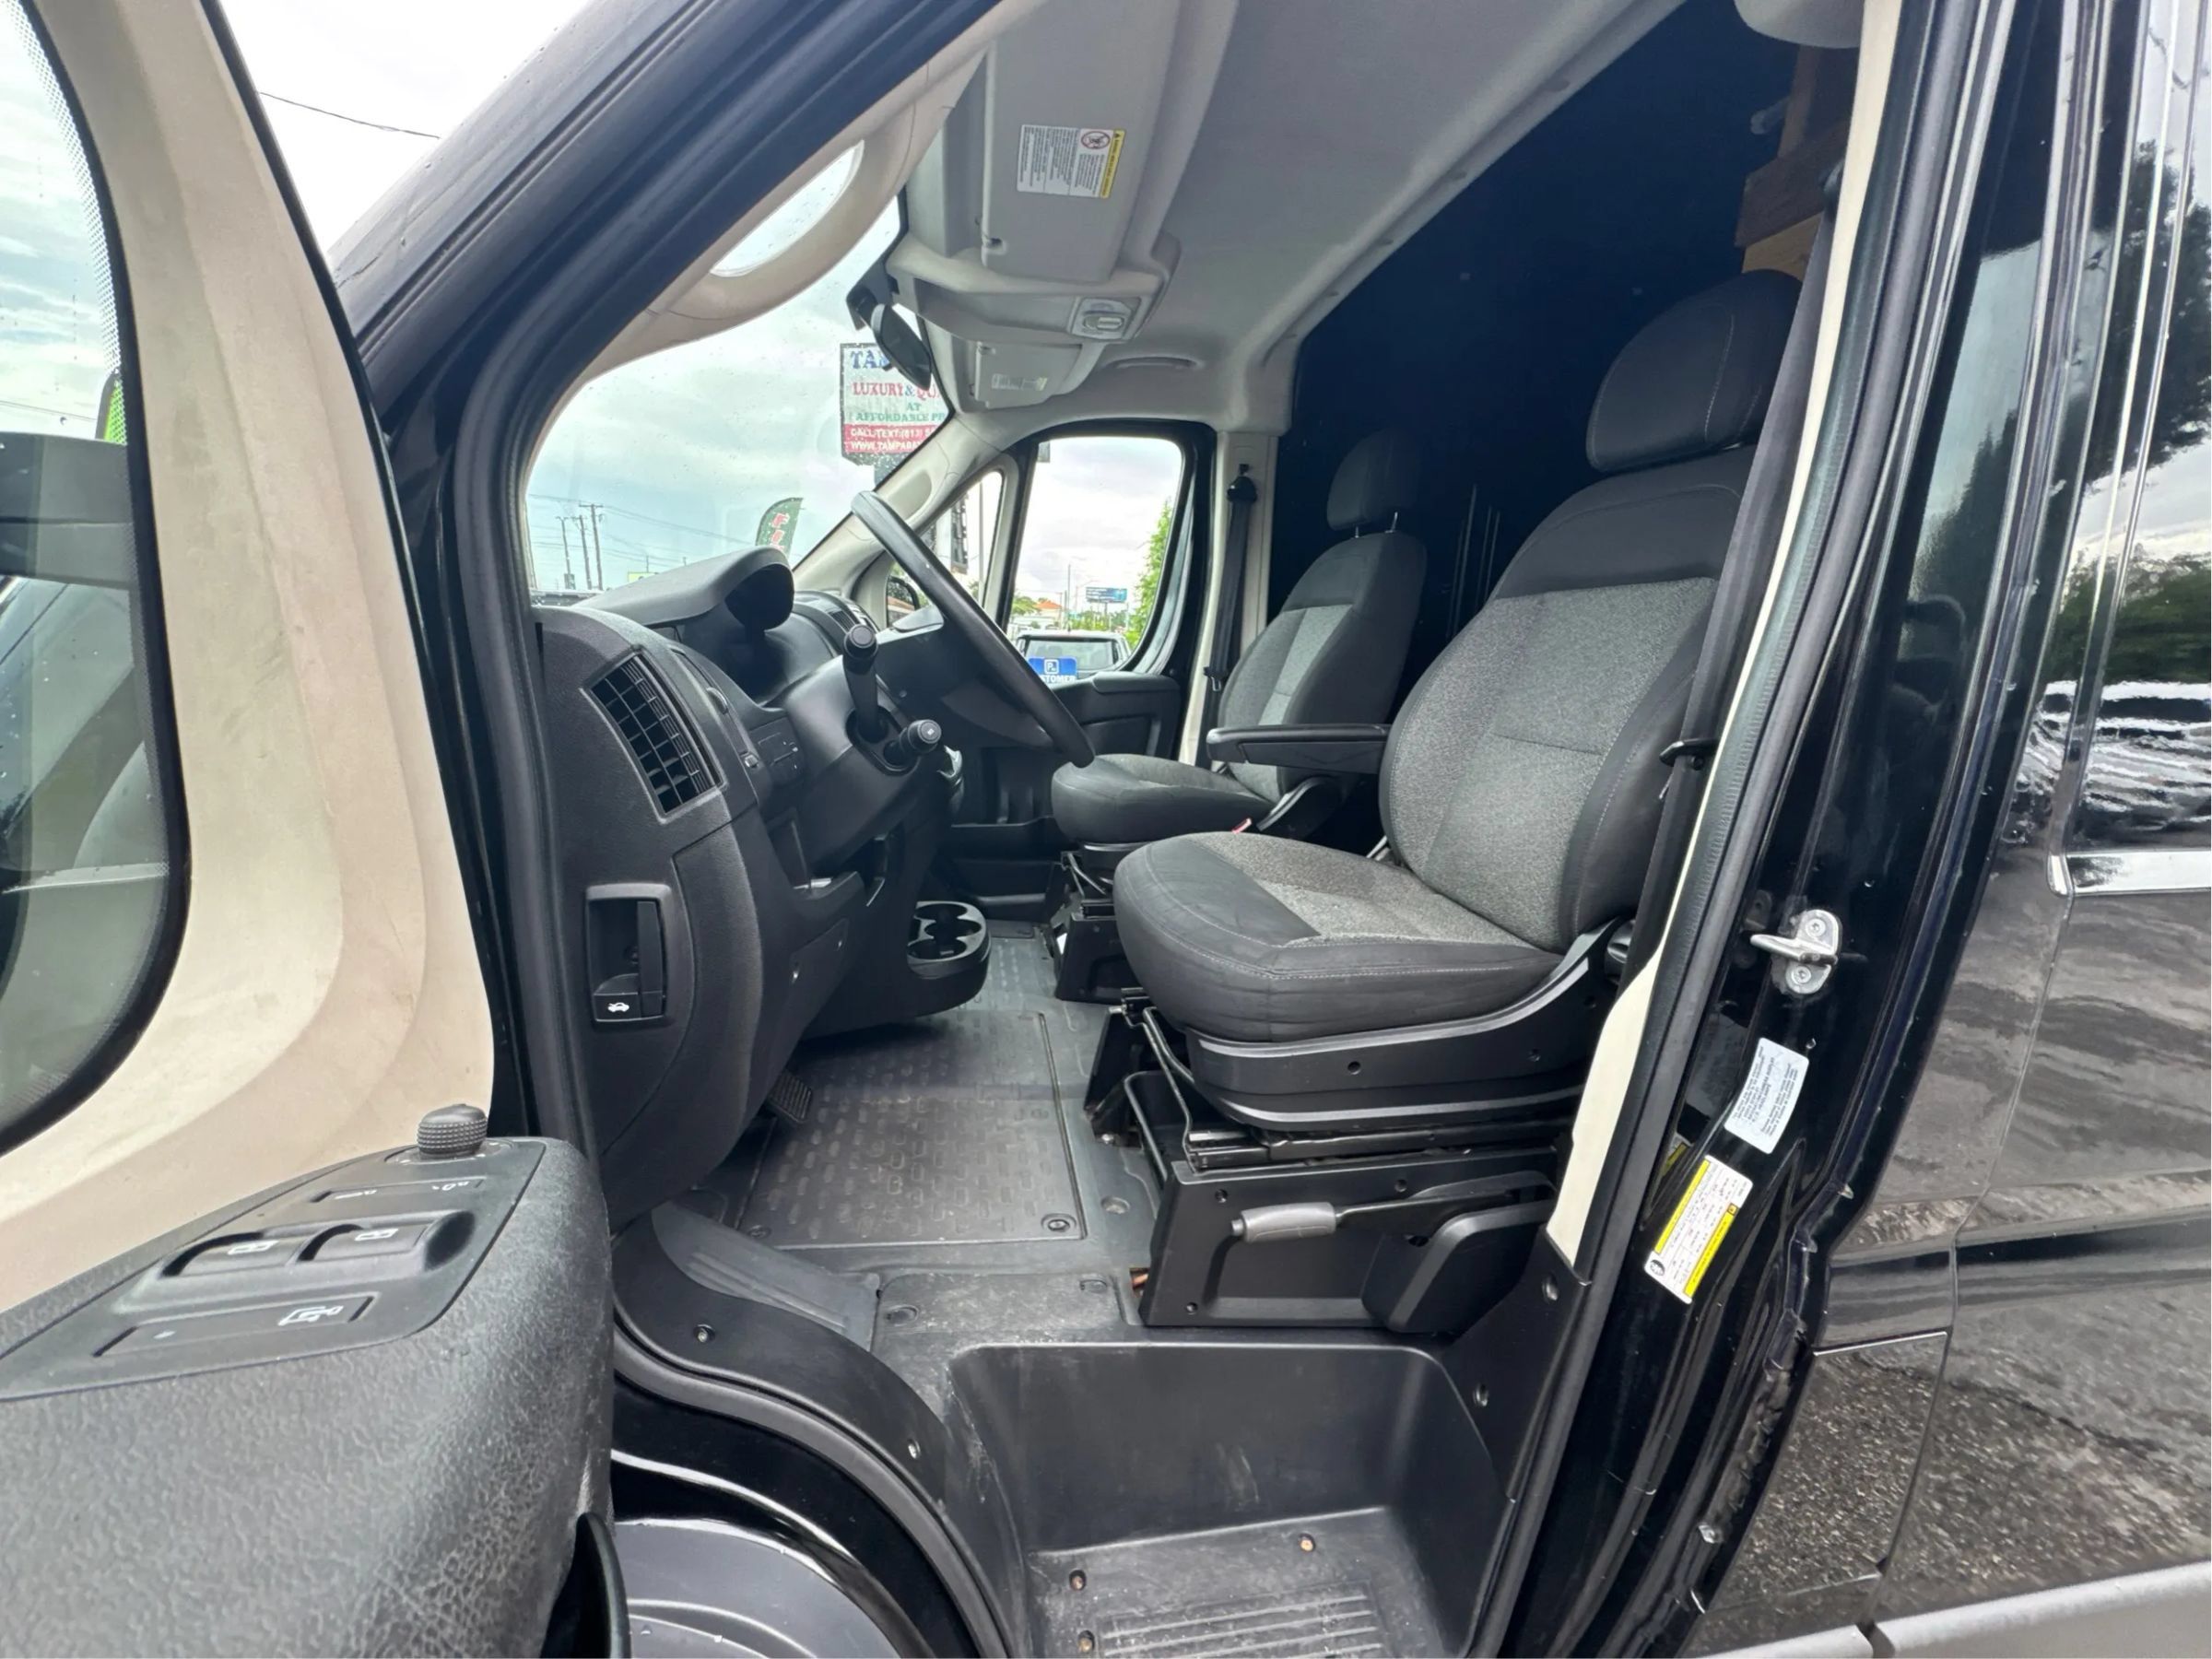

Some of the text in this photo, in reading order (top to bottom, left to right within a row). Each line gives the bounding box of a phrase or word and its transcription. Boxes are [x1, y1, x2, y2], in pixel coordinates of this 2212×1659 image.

[853, 382, 904, 396] LUXURY
[905, 384, 915, 396] &
[906, 402, 922, 411] AT
[855, 412, 929, 421] AFFORDABLE
